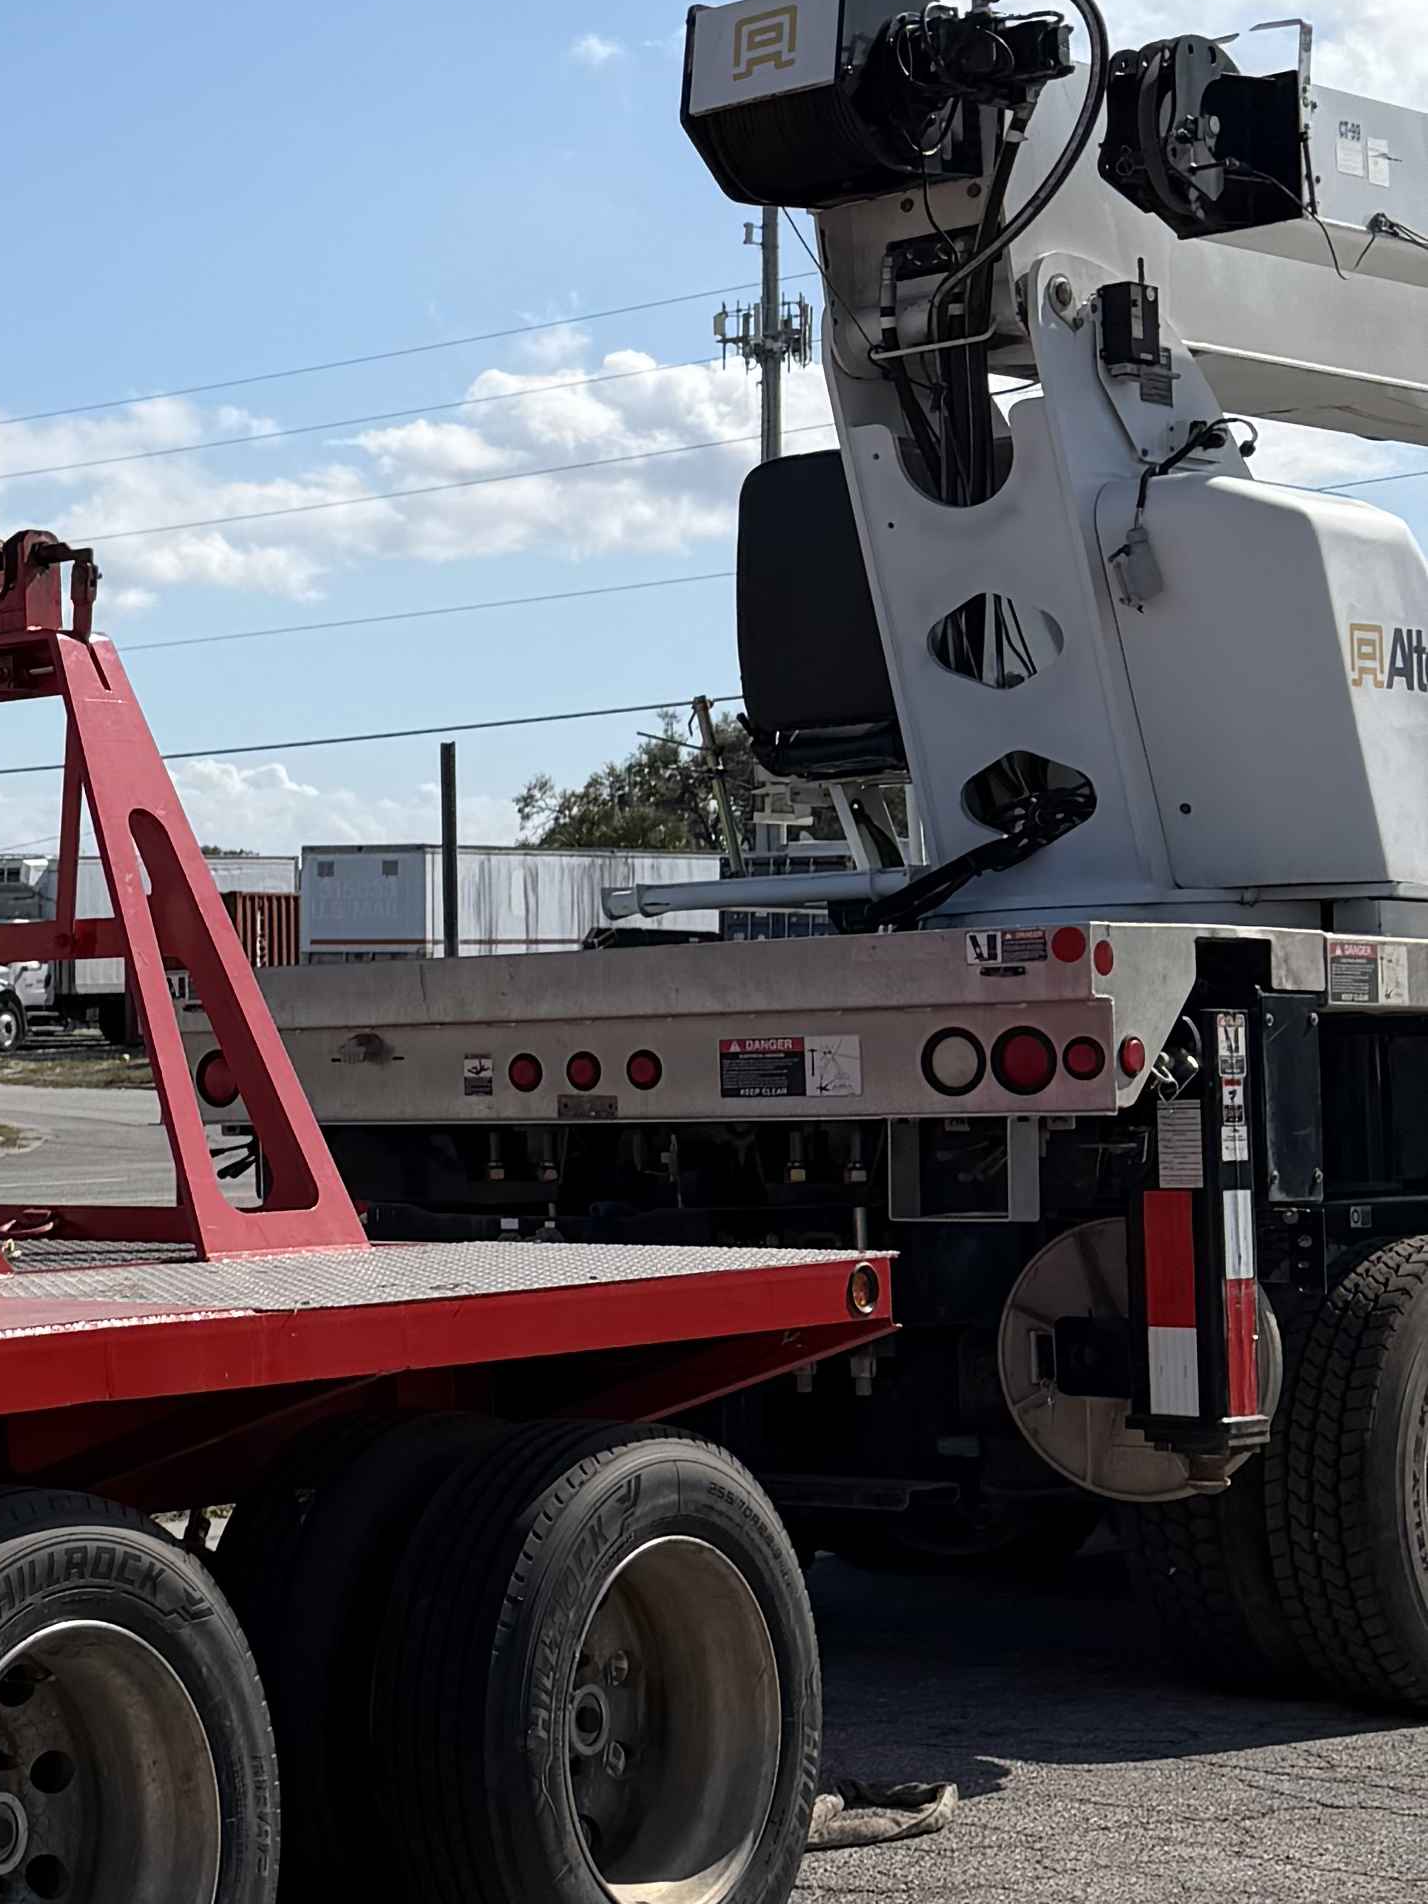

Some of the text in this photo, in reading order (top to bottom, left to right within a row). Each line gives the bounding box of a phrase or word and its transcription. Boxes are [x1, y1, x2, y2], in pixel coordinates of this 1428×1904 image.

[1386, 627, 1428, 692] Alt
[745, 1039, 793, 1050] DANGER
[740, 1087, 787, 1096] KEEP CLEAR
